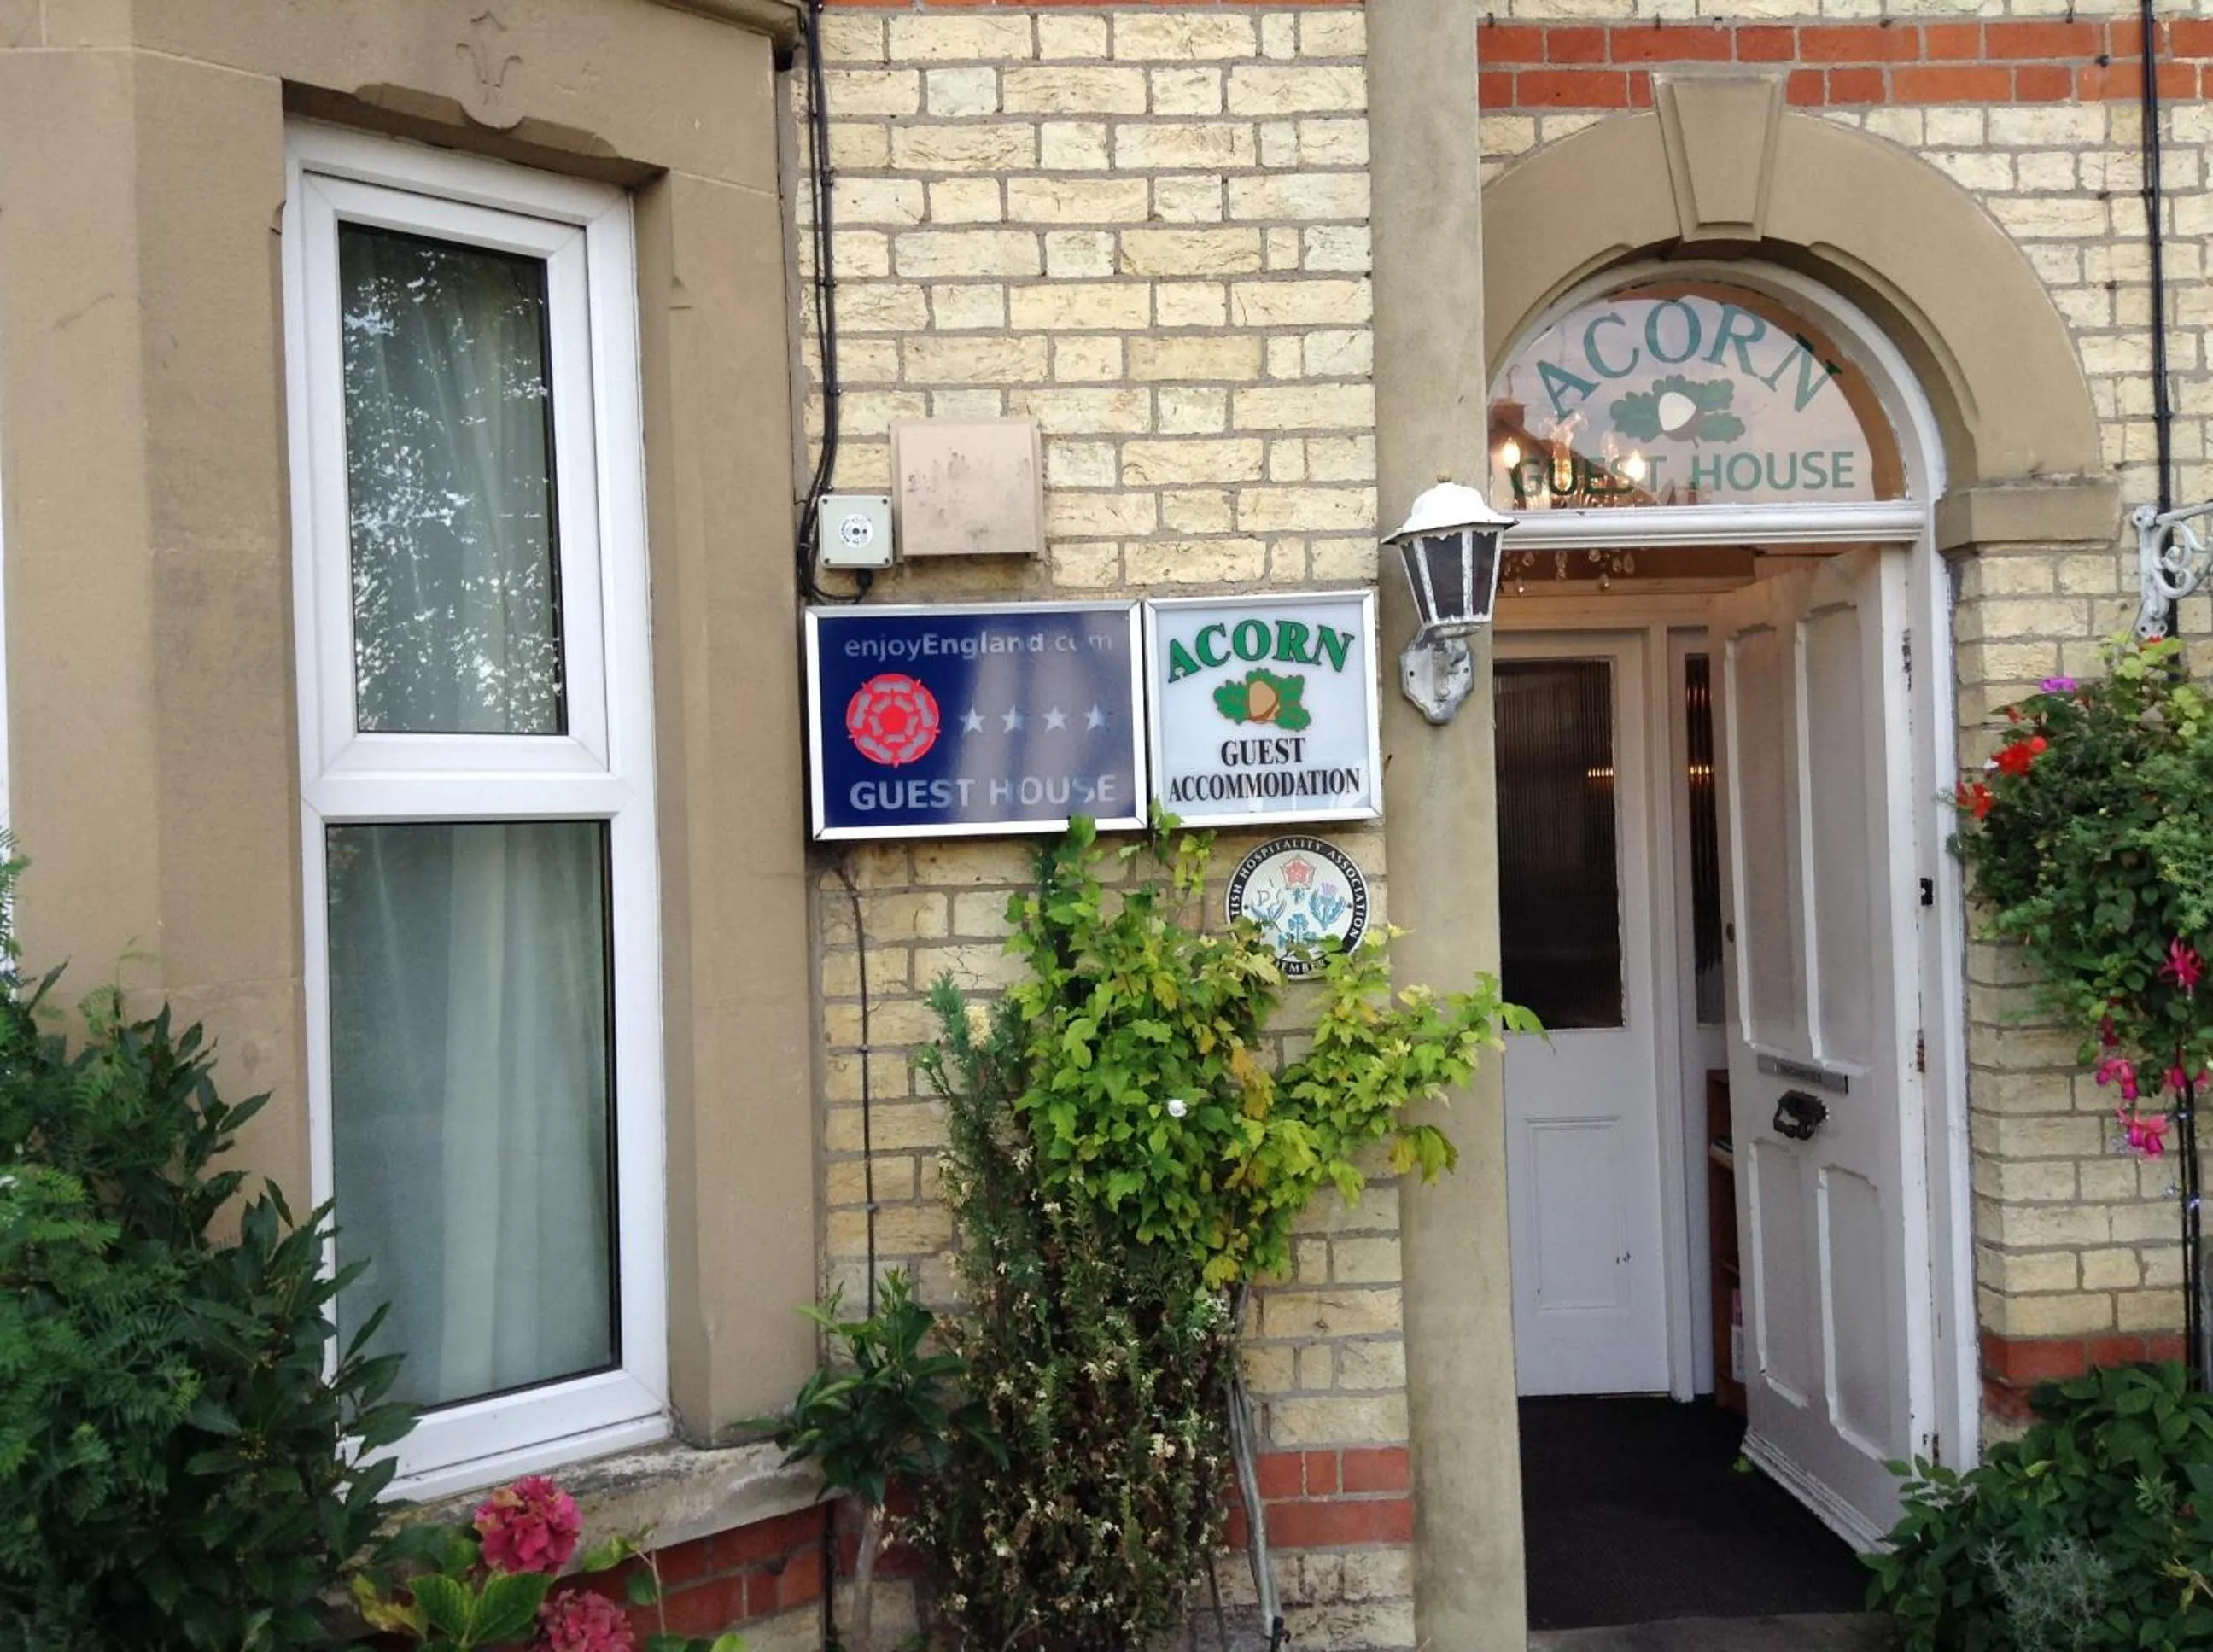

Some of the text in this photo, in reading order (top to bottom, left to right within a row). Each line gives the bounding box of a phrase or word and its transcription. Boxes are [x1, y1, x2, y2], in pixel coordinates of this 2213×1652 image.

[1536, 300, 1842, 421] ACORN
[1509, 450, 1854, 497] GUEST HOUSE
[1167, 619, 1355, 683] ACORN
[1220, 737, 1306, 767] GUEST
[849, 774, 1116, 811] GUEST HOUSE
[1168, 768, 1360, 803] ACCOMMODATION
[1239, 838, 1323, 880] HOSPITALITY
[1327, 850, 1366, 938] ASSOCIATION
